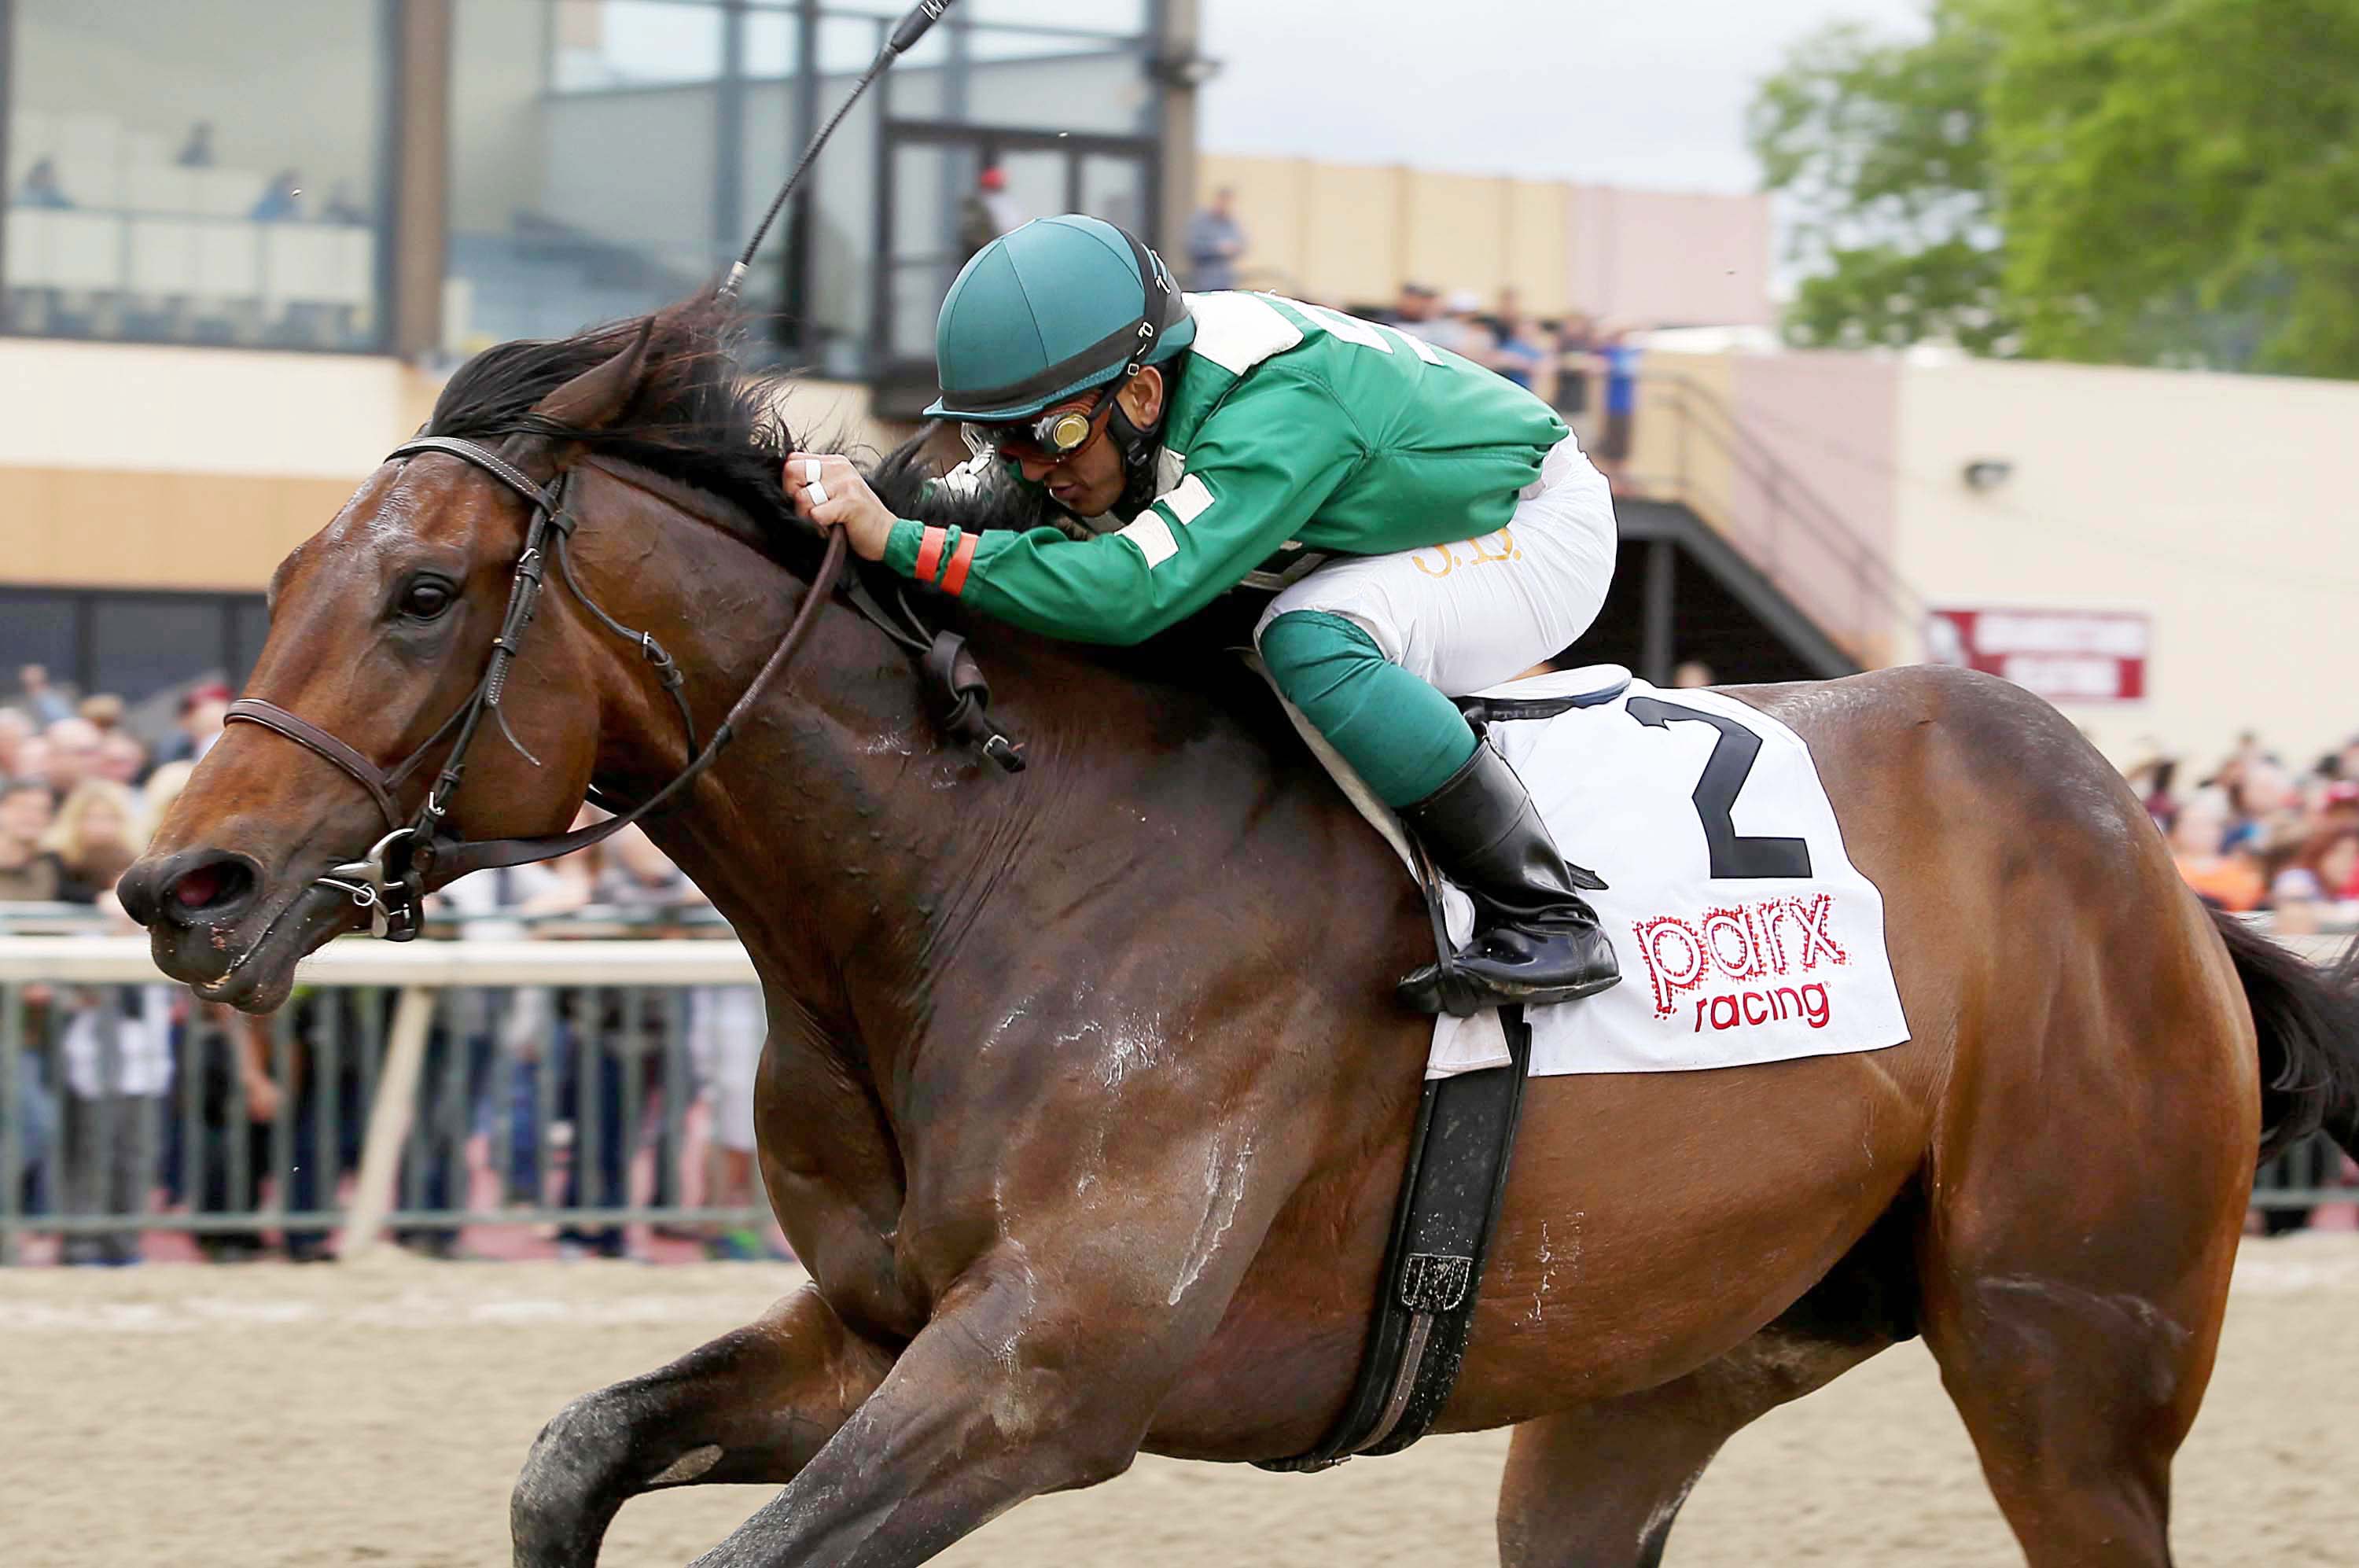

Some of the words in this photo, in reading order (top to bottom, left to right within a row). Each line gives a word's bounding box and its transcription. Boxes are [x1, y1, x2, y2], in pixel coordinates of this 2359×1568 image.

[1625, 696, 1812, 879] 2
[1632, 893, 1849, 1018] parx
[1695, 981, 1830, 1032] racing
